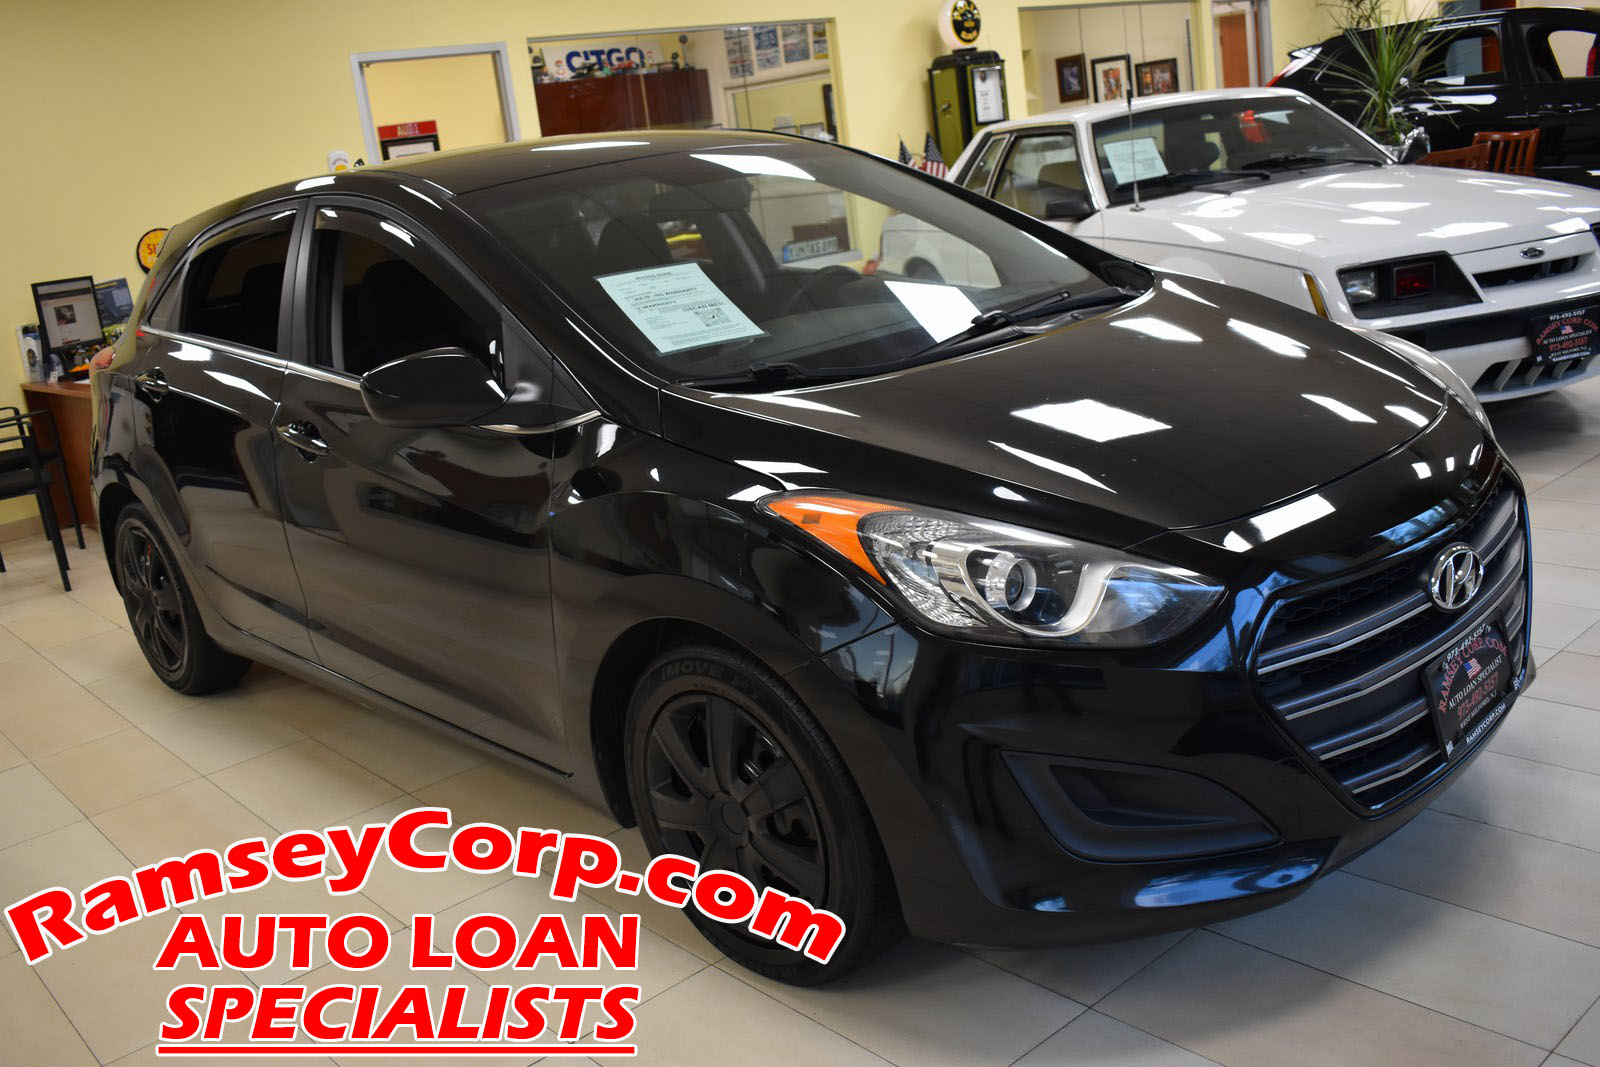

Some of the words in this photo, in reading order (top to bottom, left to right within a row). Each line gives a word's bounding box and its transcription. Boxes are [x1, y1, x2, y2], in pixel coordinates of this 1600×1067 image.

[643, 300, 677, 309] WARRANTY
[665, 287, 698, 296] WARRANTY
[1446, 623, 1486, 663] 973-492-5157
[1439, 654, 1464, 713] RAMSEY
[1485, 636, 1508, 656] COM
[1448, 690, 1464, 710] AUTO
[1462, 676, 1479, 698] LOAN
[1477, 655, 1503, 684] SPECIALIST
[1465, 702, 1507, 745] RAMSEYCORP.COM
